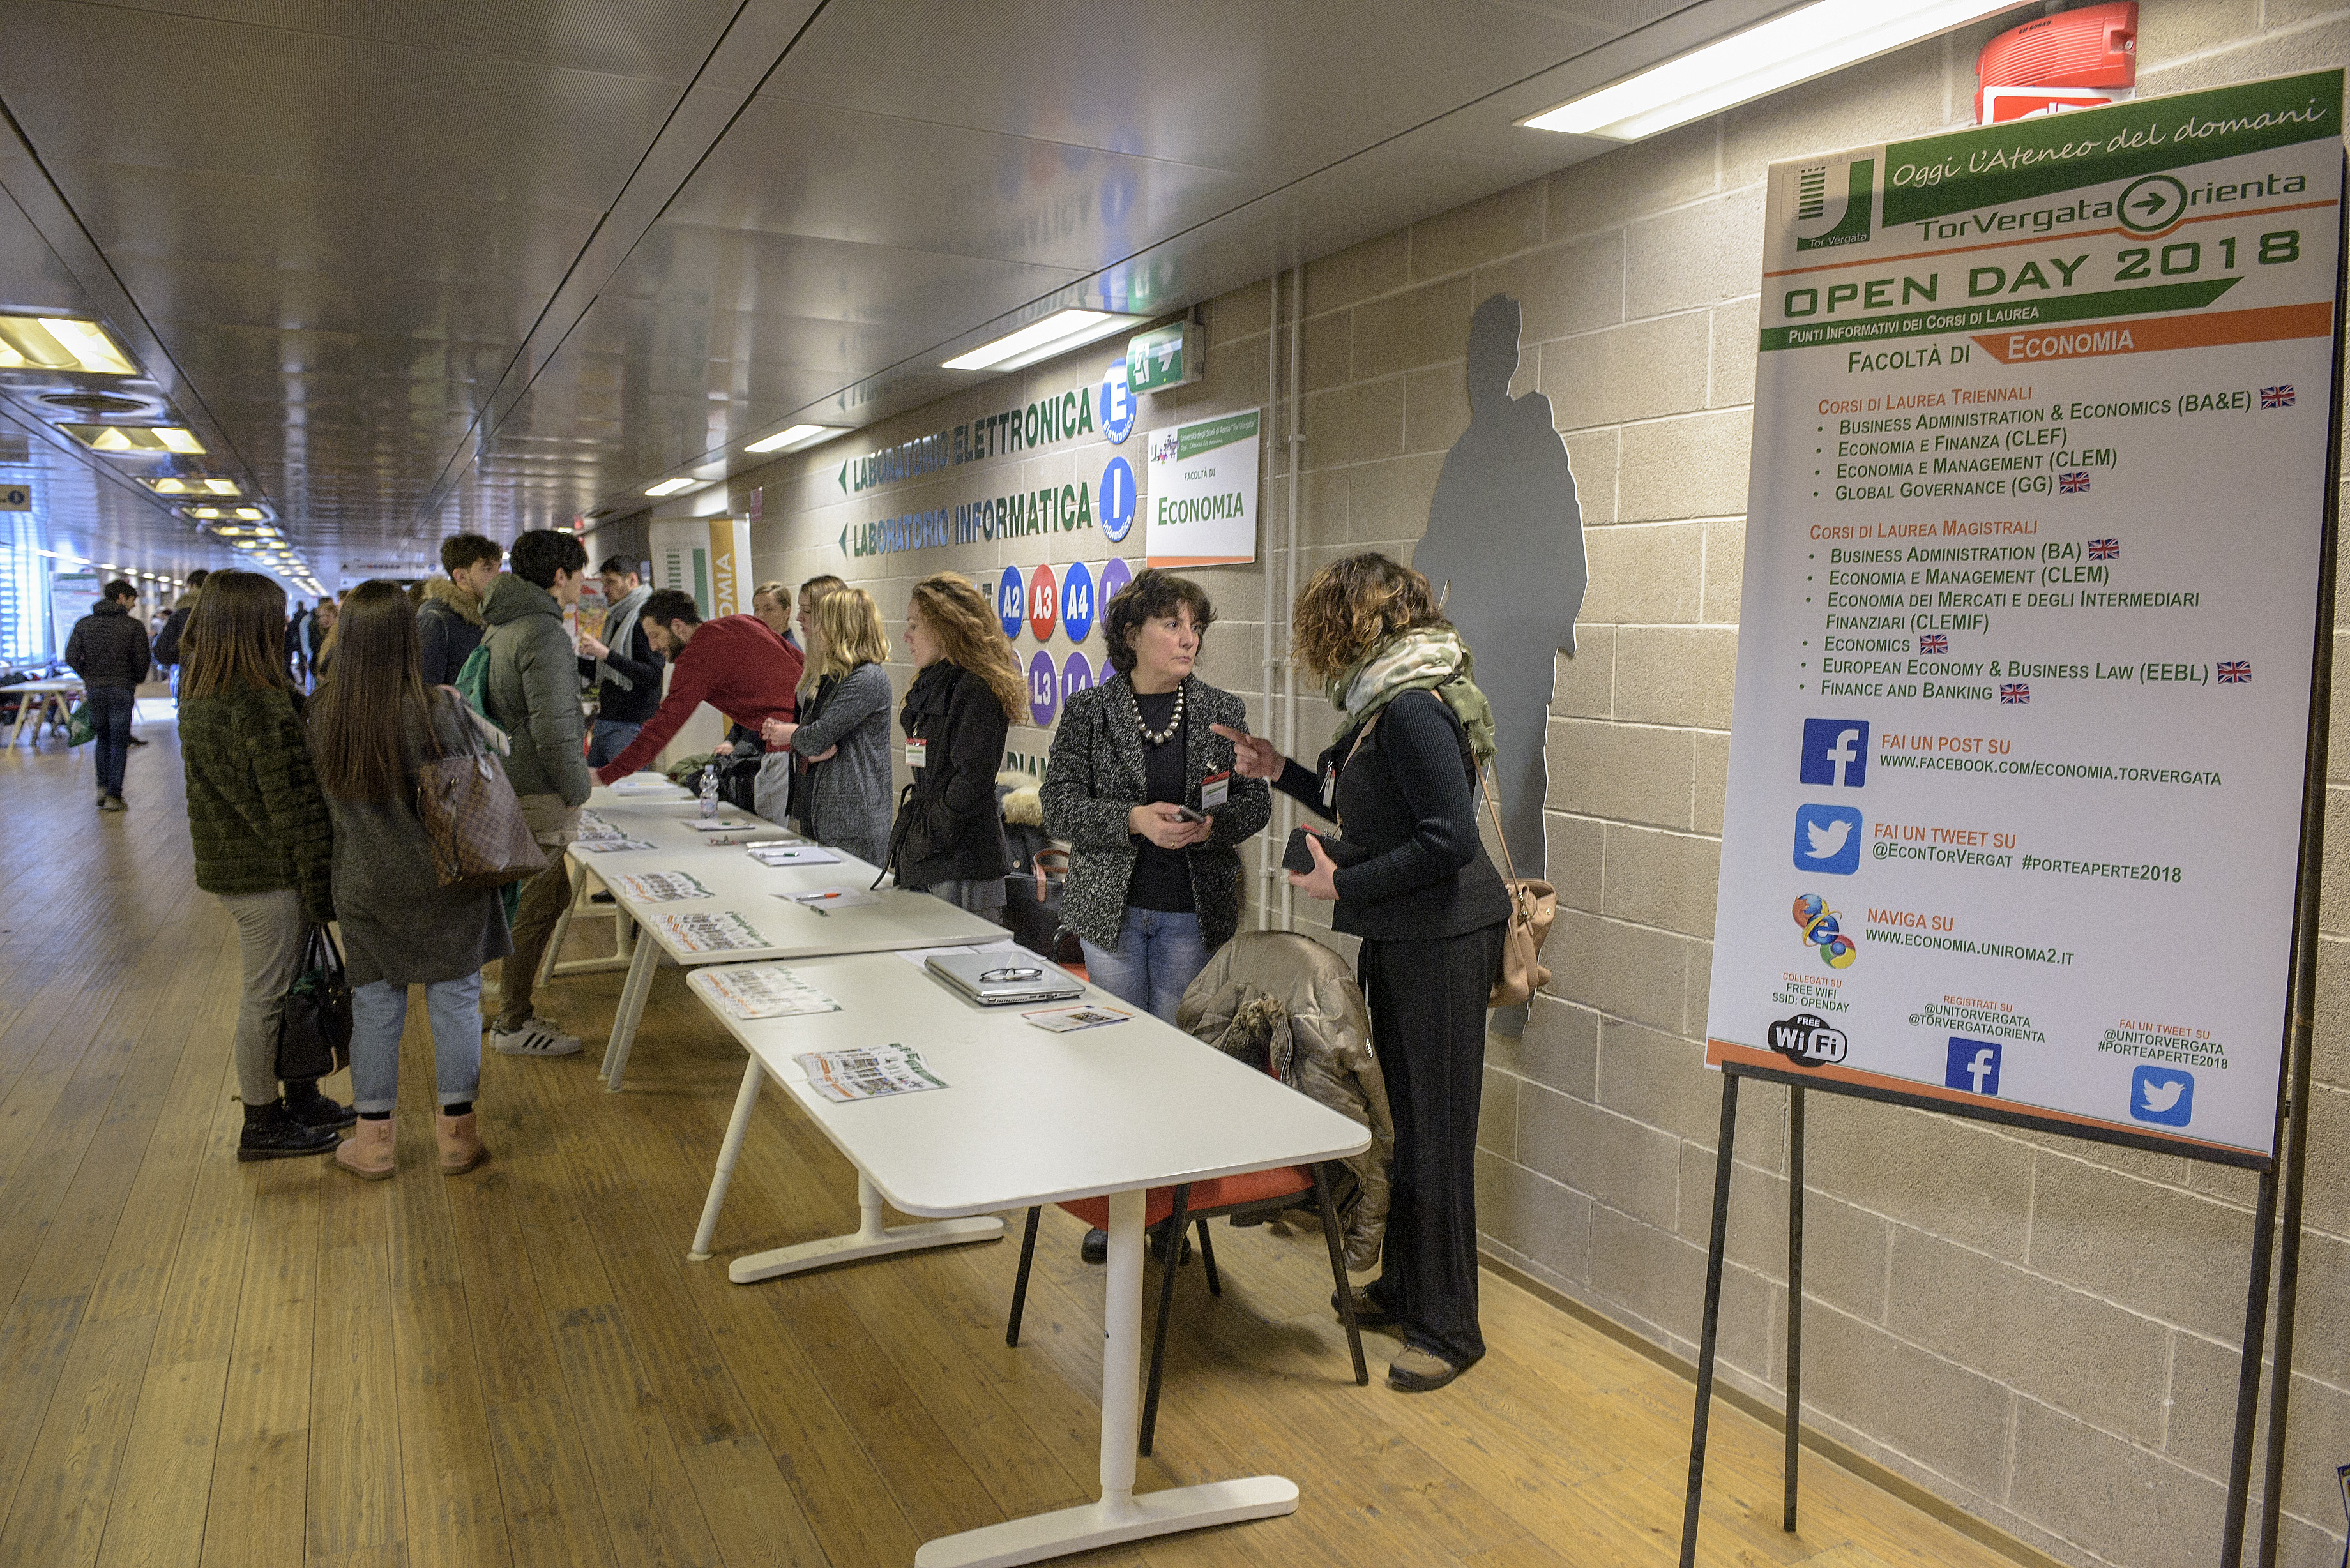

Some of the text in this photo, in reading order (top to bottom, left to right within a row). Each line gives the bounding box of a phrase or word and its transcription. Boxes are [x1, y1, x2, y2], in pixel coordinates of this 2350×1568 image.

[1893, 156, 1962, 188] Oggi
[2107, 123, 2167, 153] del
[2174, 98, 2328, 142] domani
[1847, 152, 1874, 161] Roma
[1810, 233, 1867, 248] Tor Vergata
[1784, 230, 2300, 318] OPEN DAY 2018
[1789, 306, 2039, 343] PUNTI INFORMATIVI DEI CORSI DI LAUREA
[1848, 329, 2134, 373] FACOLTÀ DI ECONOMIA
[1819, 386, 2032, 415] CORSI DI LAUREA TRIENNALI
[1840, 391, 2251, 435] BUSINESS ADMINISTRATION & ECONOMICS (BA&E)
[854, 388, 1093, 492] LABORATORIO ELETTRONICA
[1838, 427, 2067, 456] ECONOMIA E FINANZA (CLEF)
[1209, 468, 1216, 478] DI
[1837, 448, 2117, 479] ECONOMIA E MANAGEMENT (CLEM)
[1835, 475, 2053, 501] GLOBAL GOVERNANCE (GG)
[854, 482, 1093, 557] LABORATORIO INFORMATICA
[1158, 492, 1243, 525] ECONOMIA
[1810, 520, 2038, 540] CORSI DI LAUREA MAGISTRALI
[1831, 543, 2081, 564] BUSINESS ADMINISTRATION (BA)
[1829, 566, 2109, 587] ECONOMIA E MANAGEMENT (CLEM)
[1003, 585, 1020, 618] A2
[1033, 585, 1052, 619] A3
[1067, 585, 1088, 619] A4
[1828, 590, 2200, 607] ECONOMIA DEI MERCATI E DEGLI INTERMEDIARI
[1826, 614, 1989, 635] FINANZIARI (CLEMIF)
[1824, 636, 1910, 652] ECONOMICS
[1823, 658, 2209, 686] EUROPEAN ECONOMY & BUSINESS LAW (EEBL)
[1035, 671, 1051, 705] L3
[1821, 679, 1993, 700] FINANCE AND BANKING
[1882, 734, 2011, 755] FAI UN POST SU
[1880, 755, 2222, 786] WWW.FACEBOOK.COM/ECONOMIA.TORVERGATA
[1874, 824, 2017, 849] FAI UN TWEET SU
[1872, 841, 2182, 884] @ECONTORVERGAT #PORTEAPERTE2018
[1867, 908, 1954, 933] NAVIGA SU
[1865, 928, 2074, 965] WWW.ECONOMIA.UNIROMA2.IT
[1783, 972, 1842, 988] COLLEGATI SU
[1787, 983, 1837, 999] FREE WIFI
[1772, 993, 1849, 1013] SSID: OPENDAY
[1924, 1003, 2031, 1028] @UNITORVERGATA
[1944, 995, 2013, 1013] REGISTRATI SU
[1797, 1016, 1821, 1027] FREE
[1909, 1014, 2045, 1043] @TORVERGATAORIENTA
[2119, 1019, 2210, 1039] FAI UN TWEET SU
[2104, 1029, 2224, 1055] @UNITORVERGATA
[2098, 1041, 2228, 1070] #PORTEAPERTE2018
